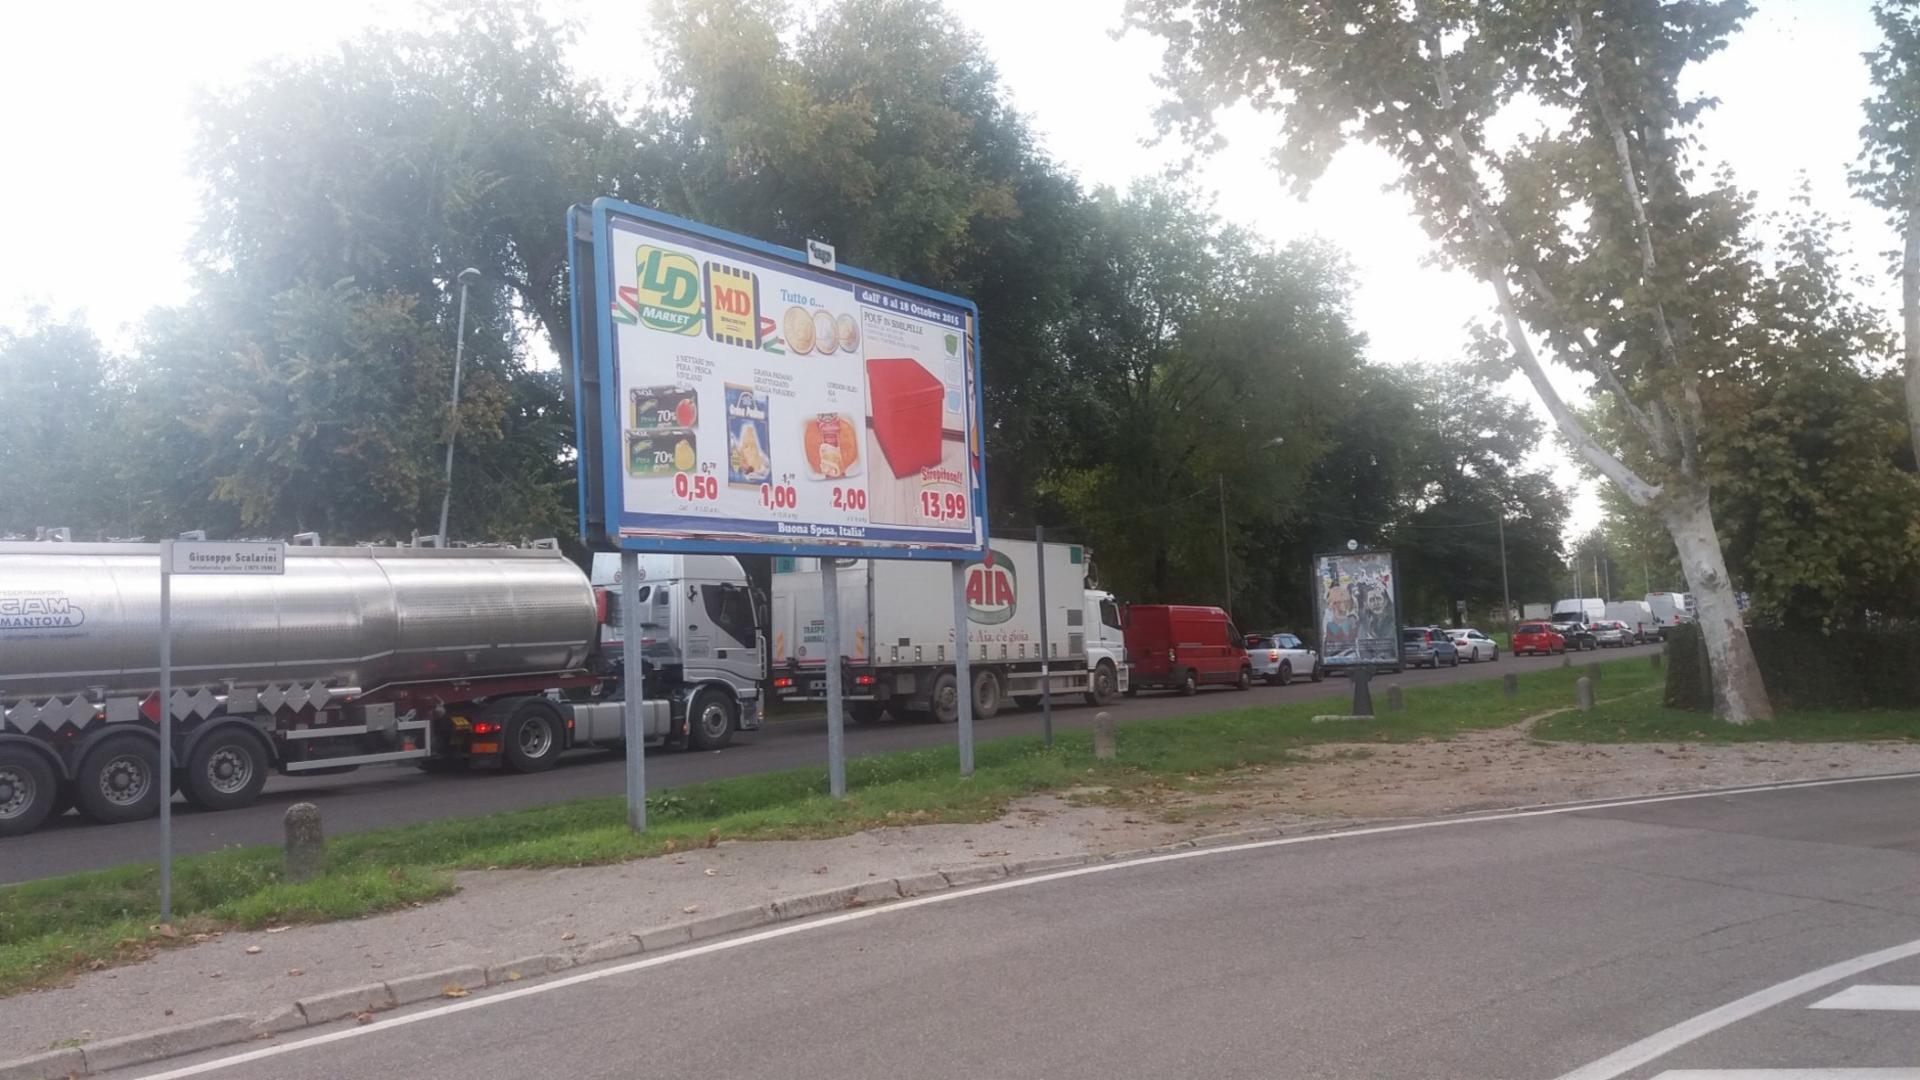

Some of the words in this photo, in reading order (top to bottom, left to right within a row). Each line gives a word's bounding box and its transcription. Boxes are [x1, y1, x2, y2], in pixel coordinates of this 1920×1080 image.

[643, 250, 698, 308] LD
[713, 284, 751, 316] MD
[780, 288, 808, 305] Tutto
[642, 306, 691, 325] MARKET
[910, 302, 941, 320] Ottobre
[942, 311, 960, 326] 2015
[675, 473, 718, 502] 0,50
[761, 484, 797, 511] 1,00
[832, 487, 867, 511] 2,00
[921, 491, 966, 521] 13,99
[777, 522, 808, 534] Buona
[839, 527, 865, 537] Italia!
[188, 552, 232, 564] Giuseppe
[235, 552, 277, 562] Scalarini
[966, 560, 1015, 605] AIA
[1, 616, 72, 627] MANTOVA
